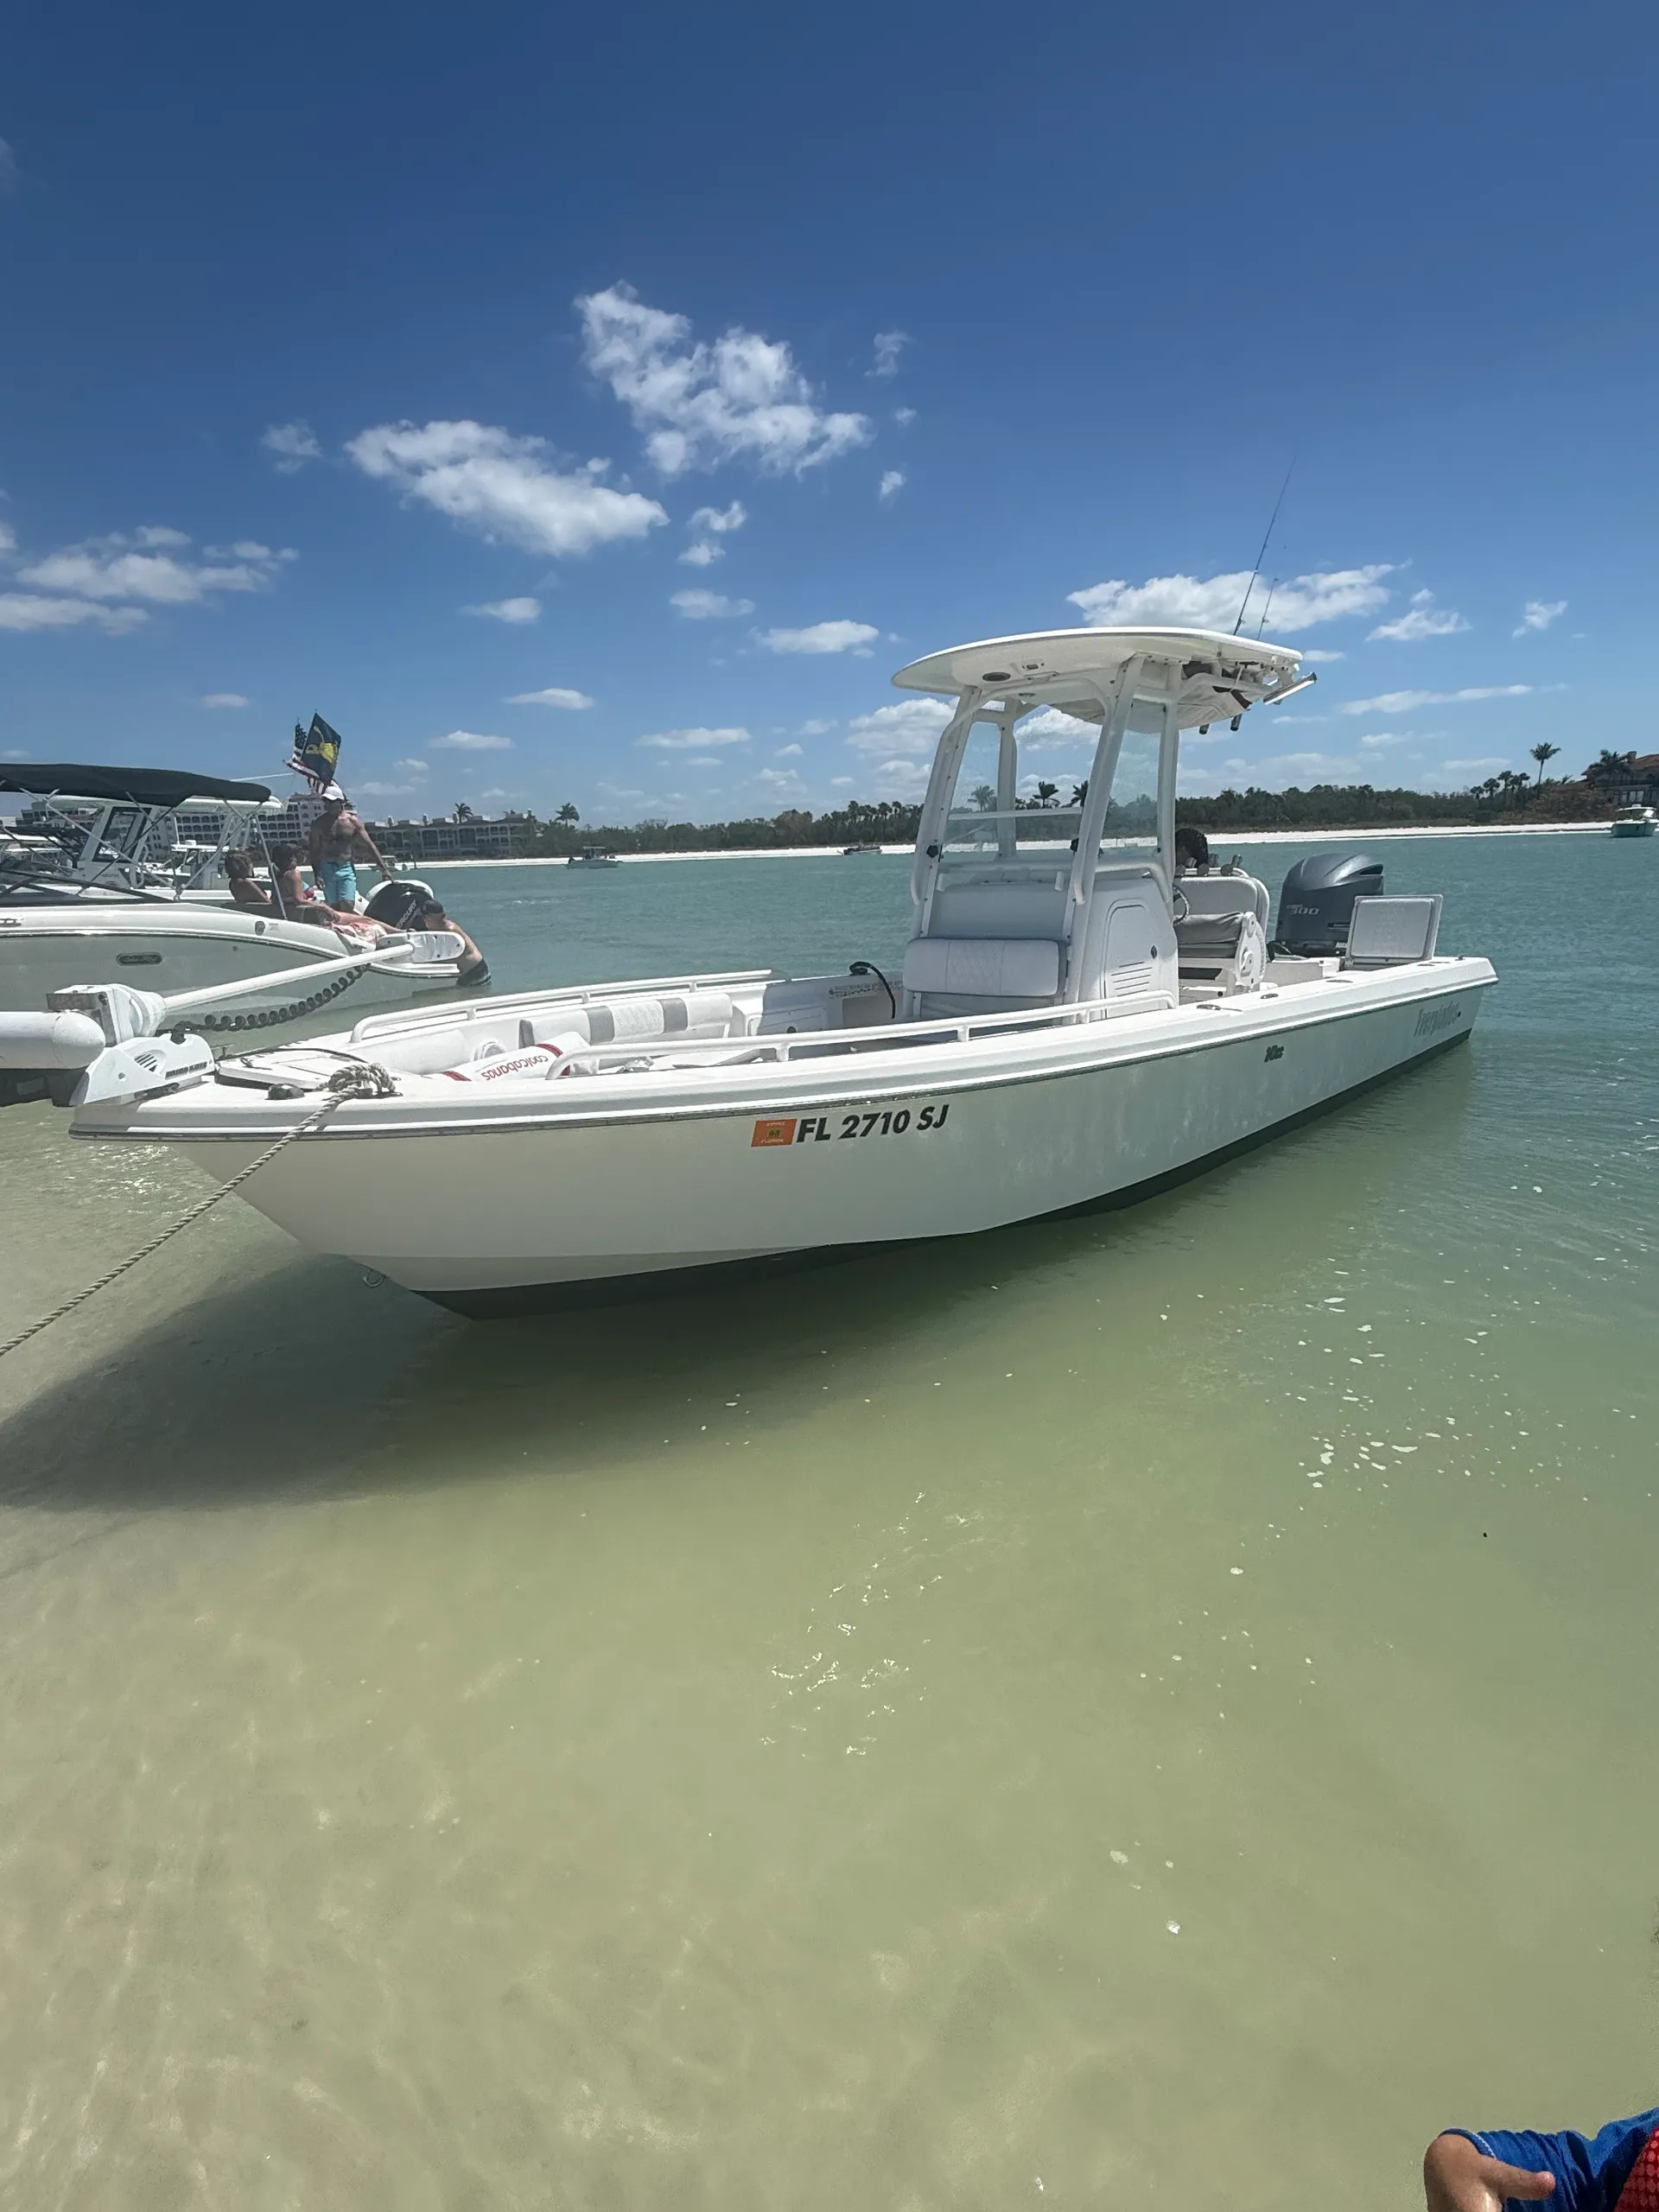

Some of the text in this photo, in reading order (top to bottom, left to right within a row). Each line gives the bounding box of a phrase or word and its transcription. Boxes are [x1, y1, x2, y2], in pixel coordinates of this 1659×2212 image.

[397, 899, 416, 930] ERCURY
[480, 1055, 549, 1081] coolcabanas
[796, 1103, 950, 1143] FL 2710 SJ
